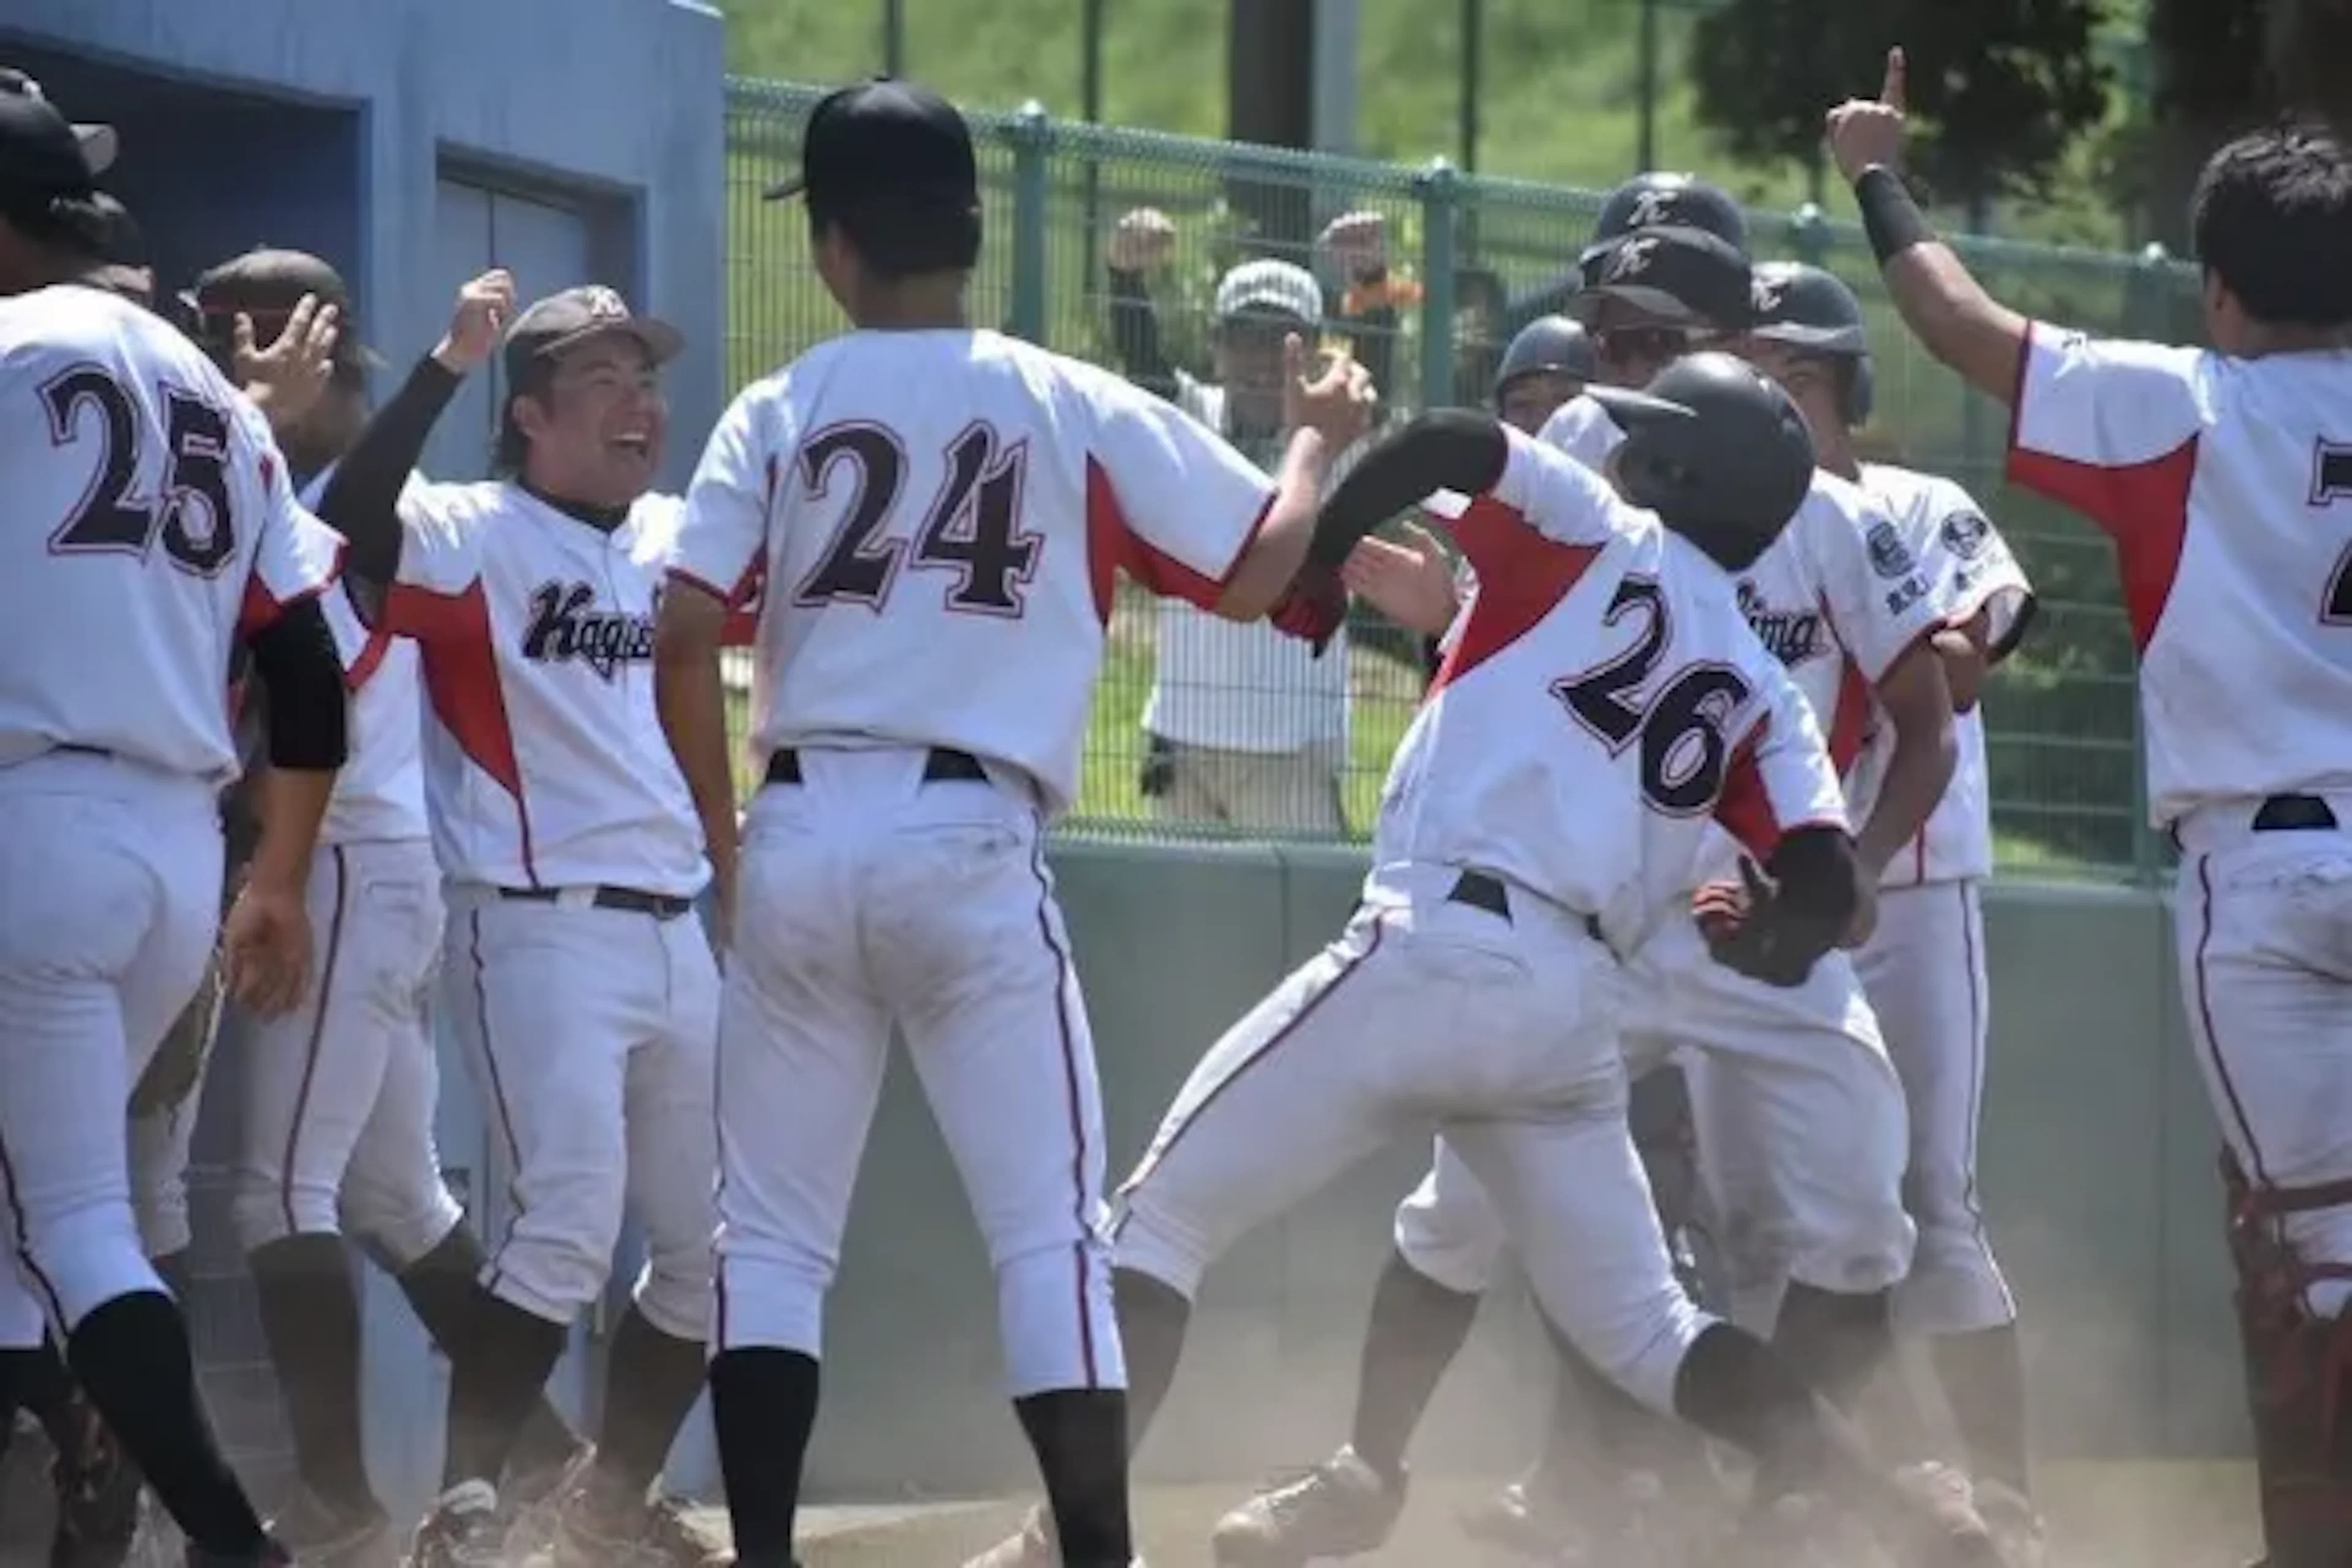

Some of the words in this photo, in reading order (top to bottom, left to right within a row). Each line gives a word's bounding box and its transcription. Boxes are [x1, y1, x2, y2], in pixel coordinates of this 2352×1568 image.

[37, 362, 237, 579] 25
[792, 416, 1045, 617] 24
[1548, 571, 1757, 819] 26
